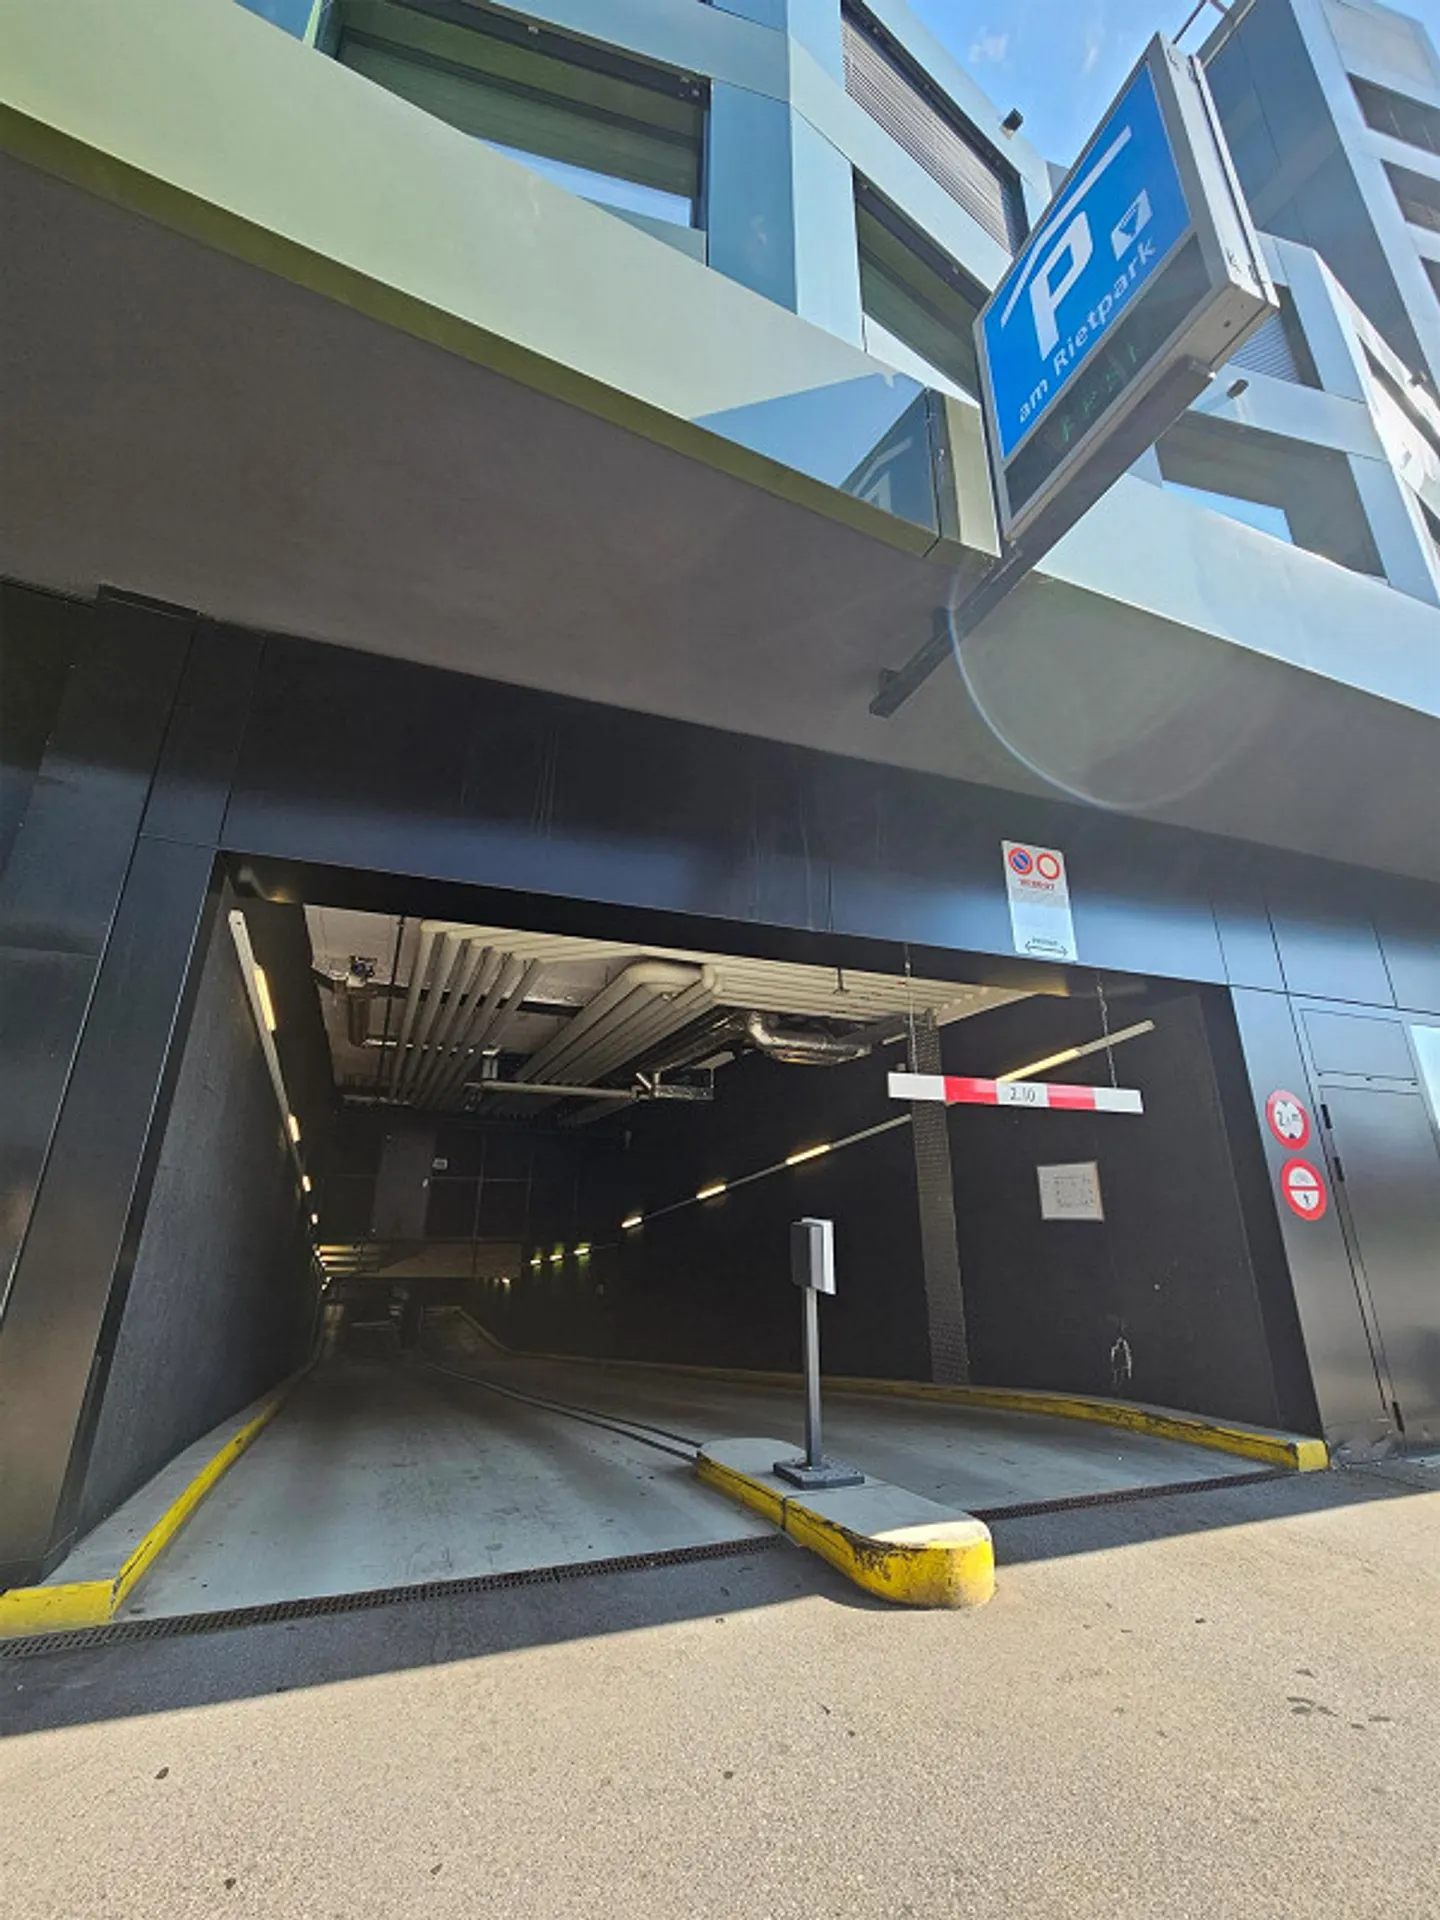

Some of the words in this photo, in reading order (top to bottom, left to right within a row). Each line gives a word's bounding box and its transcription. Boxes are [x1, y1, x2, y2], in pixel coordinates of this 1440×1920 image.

[1018, 378, 1049, 424] am
[1052, 235, 1157, 377] Rietpark
[1029, 211, 1093, 361] P
